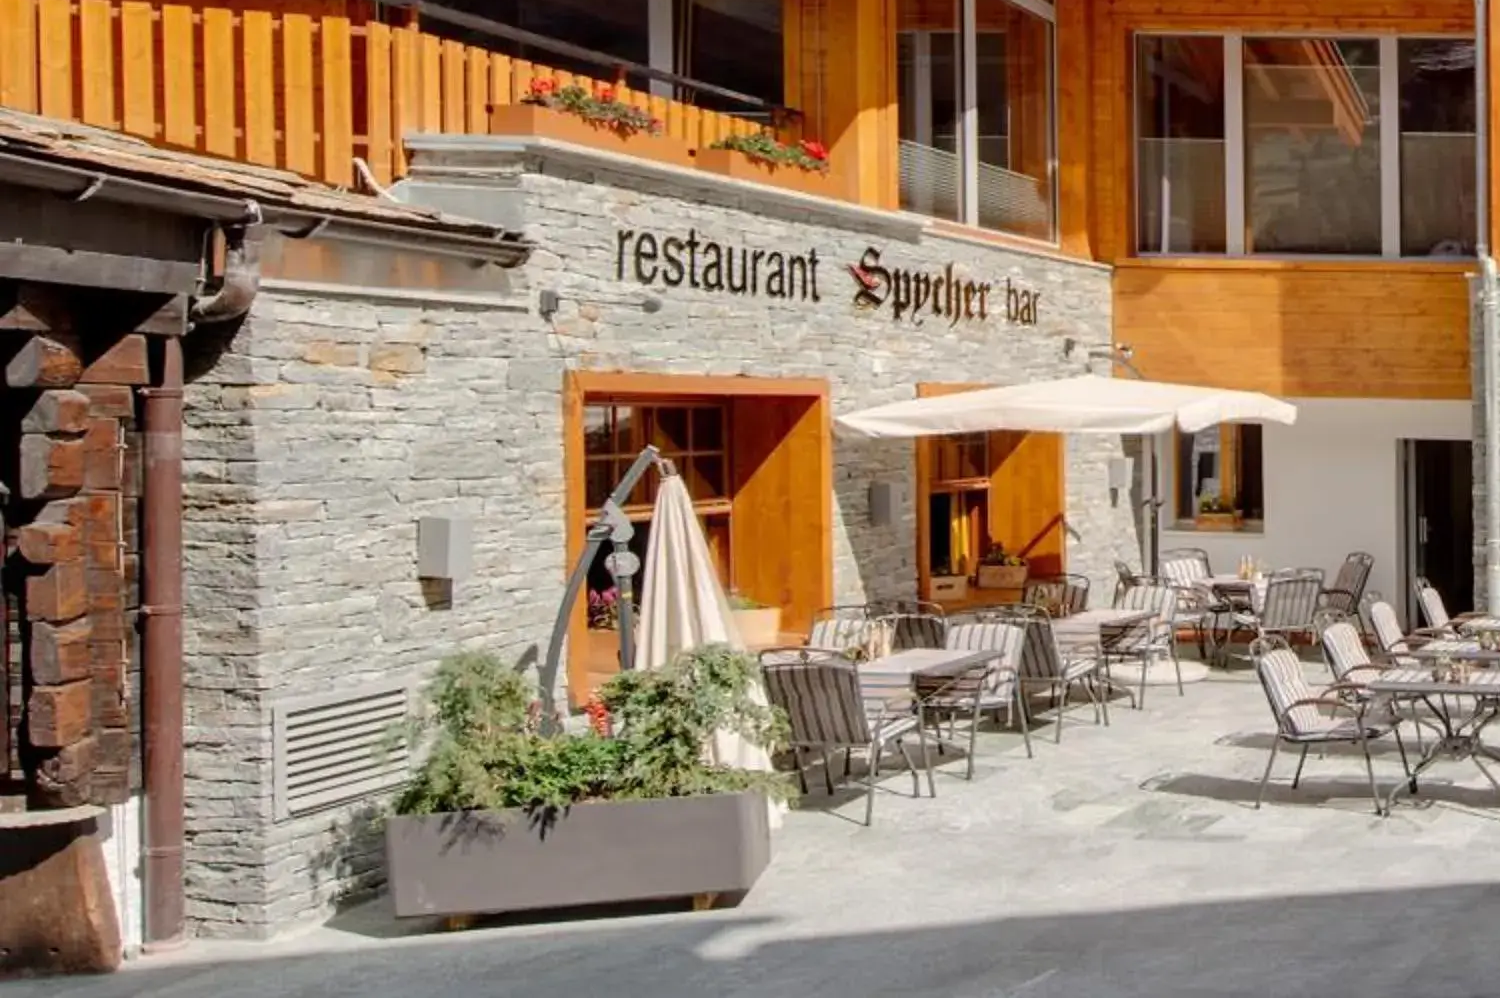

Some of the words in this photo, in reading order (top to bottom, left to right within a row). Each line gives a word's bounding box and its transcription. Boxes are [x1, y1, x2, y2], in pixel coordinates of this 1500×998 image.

[616, 228, 820, 302] restaurant
[848, 246, 991, 327] Spycher
[1006, 277, 1041, 325] bar
